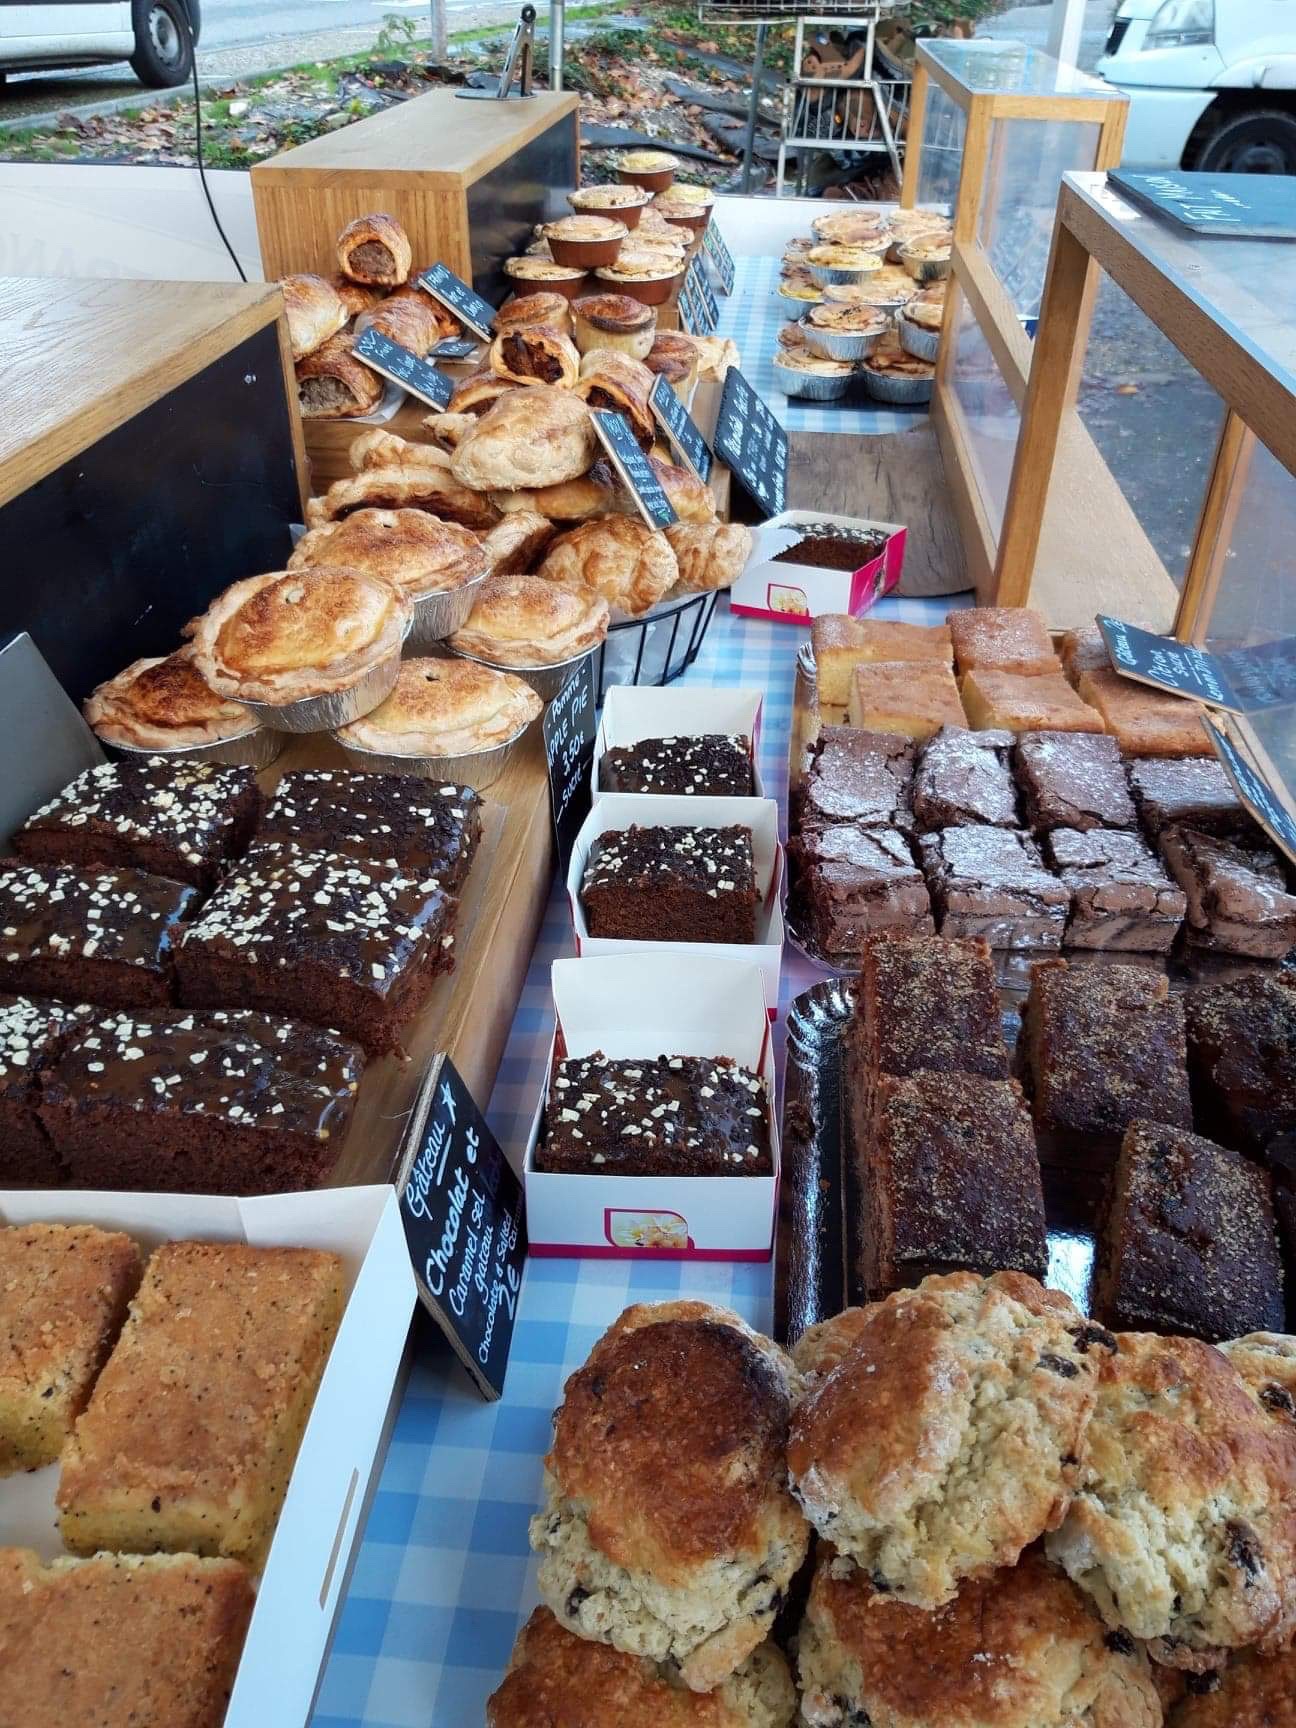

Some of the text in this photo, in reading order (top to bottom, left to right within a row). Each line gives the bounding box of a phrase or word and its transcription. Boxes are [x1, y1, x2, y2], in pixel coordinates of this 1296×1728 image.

[572, 685, 588, 727] PIE
[406, 1121, 446, 1220] Gâteau
[426, 1126, 480, 1295] Chocolat et
[449, 1188, 485, 1316] Caramel sel
[478, 1279, 502, 1364] Chocolate
